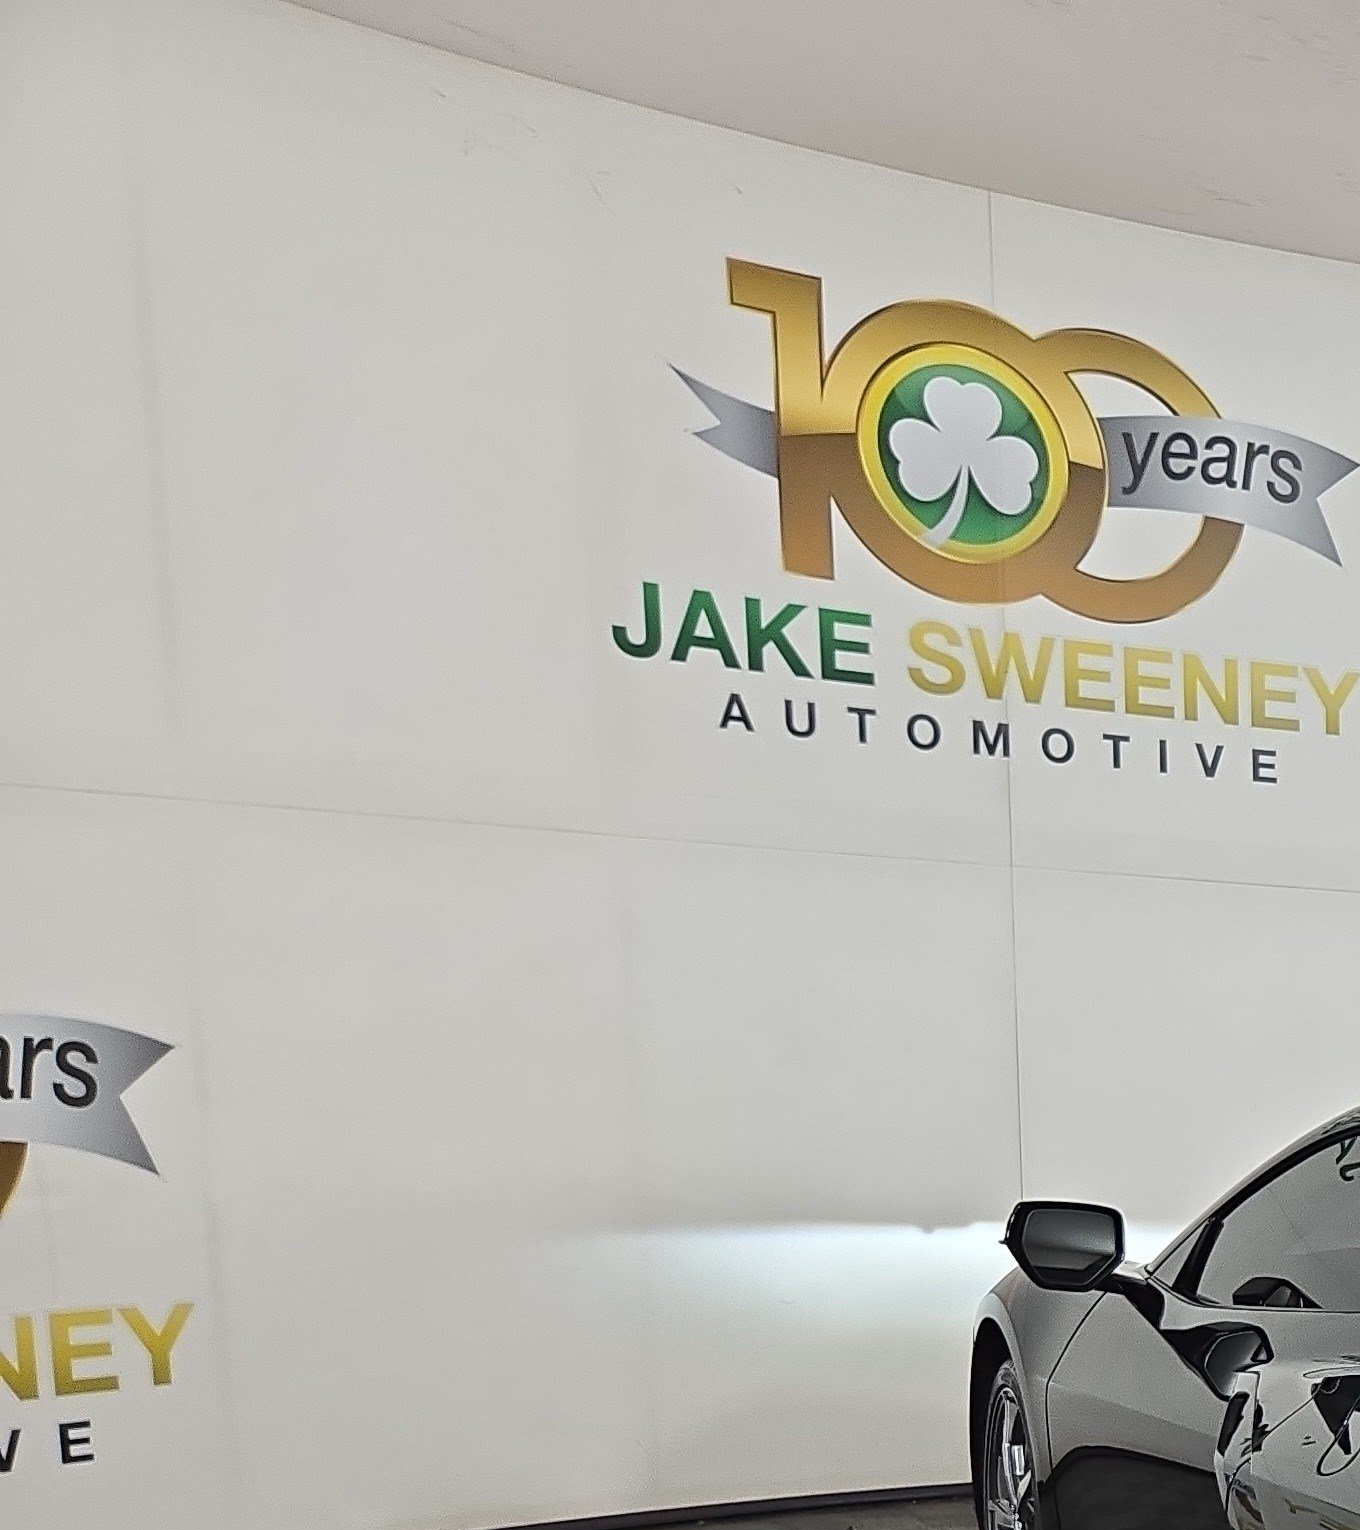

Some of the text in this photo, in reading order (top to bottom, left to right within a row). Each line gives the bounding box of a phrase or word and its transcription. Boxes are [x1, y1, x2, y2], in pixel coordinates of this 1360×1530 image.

[726, 256, 1245, 625] 100
[1120, 429, 1304, 504] years
[610, 582, 877, 686] JAKE
[718, 693, 1281, 785] AUTOMOTIVE
